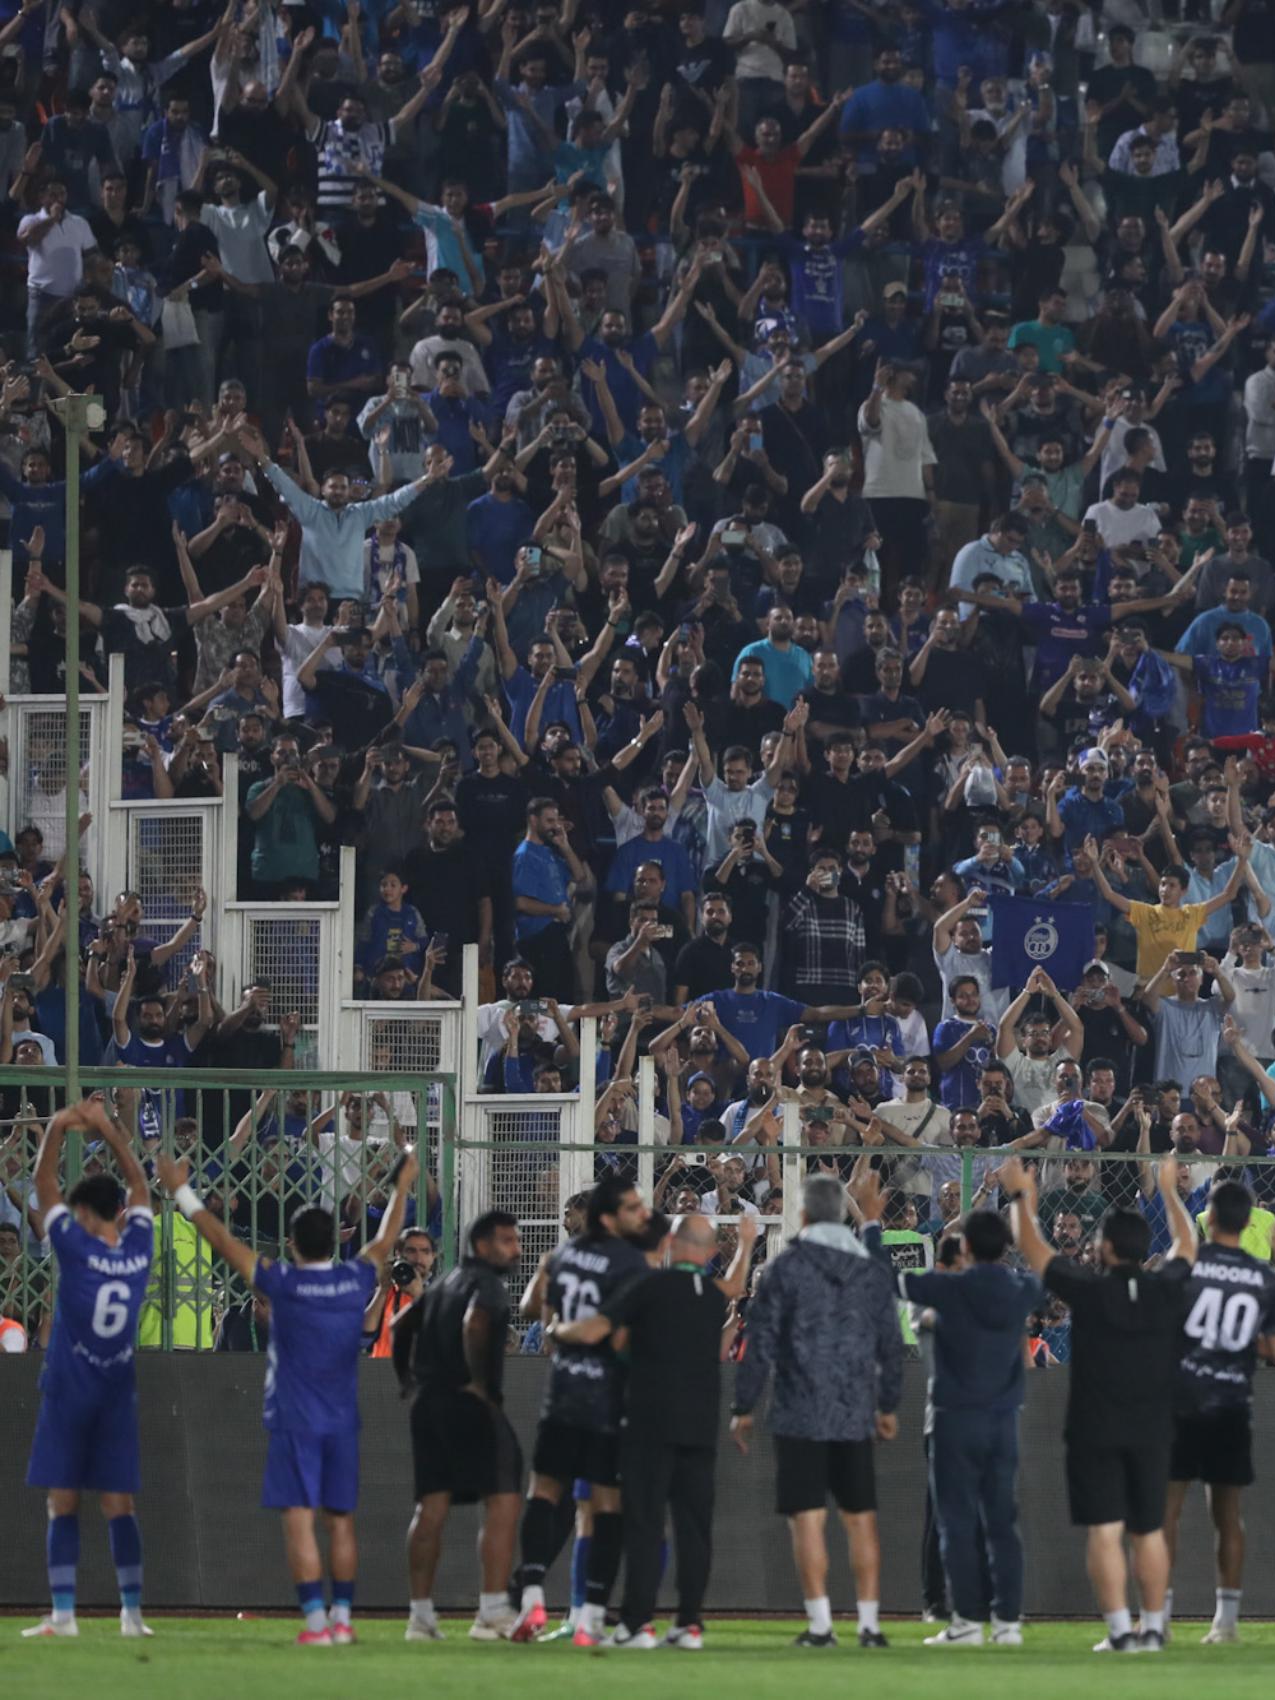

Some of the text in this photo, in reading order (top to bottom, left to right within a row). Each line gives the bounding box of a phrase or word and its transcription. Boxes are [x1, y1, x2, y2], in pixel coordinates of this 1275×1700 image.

[1191, 1261, 1265, 1288] AHOORA
[92, 1280, 131, 1339] 6
[1184, 1286, 1260, 1353] 40
